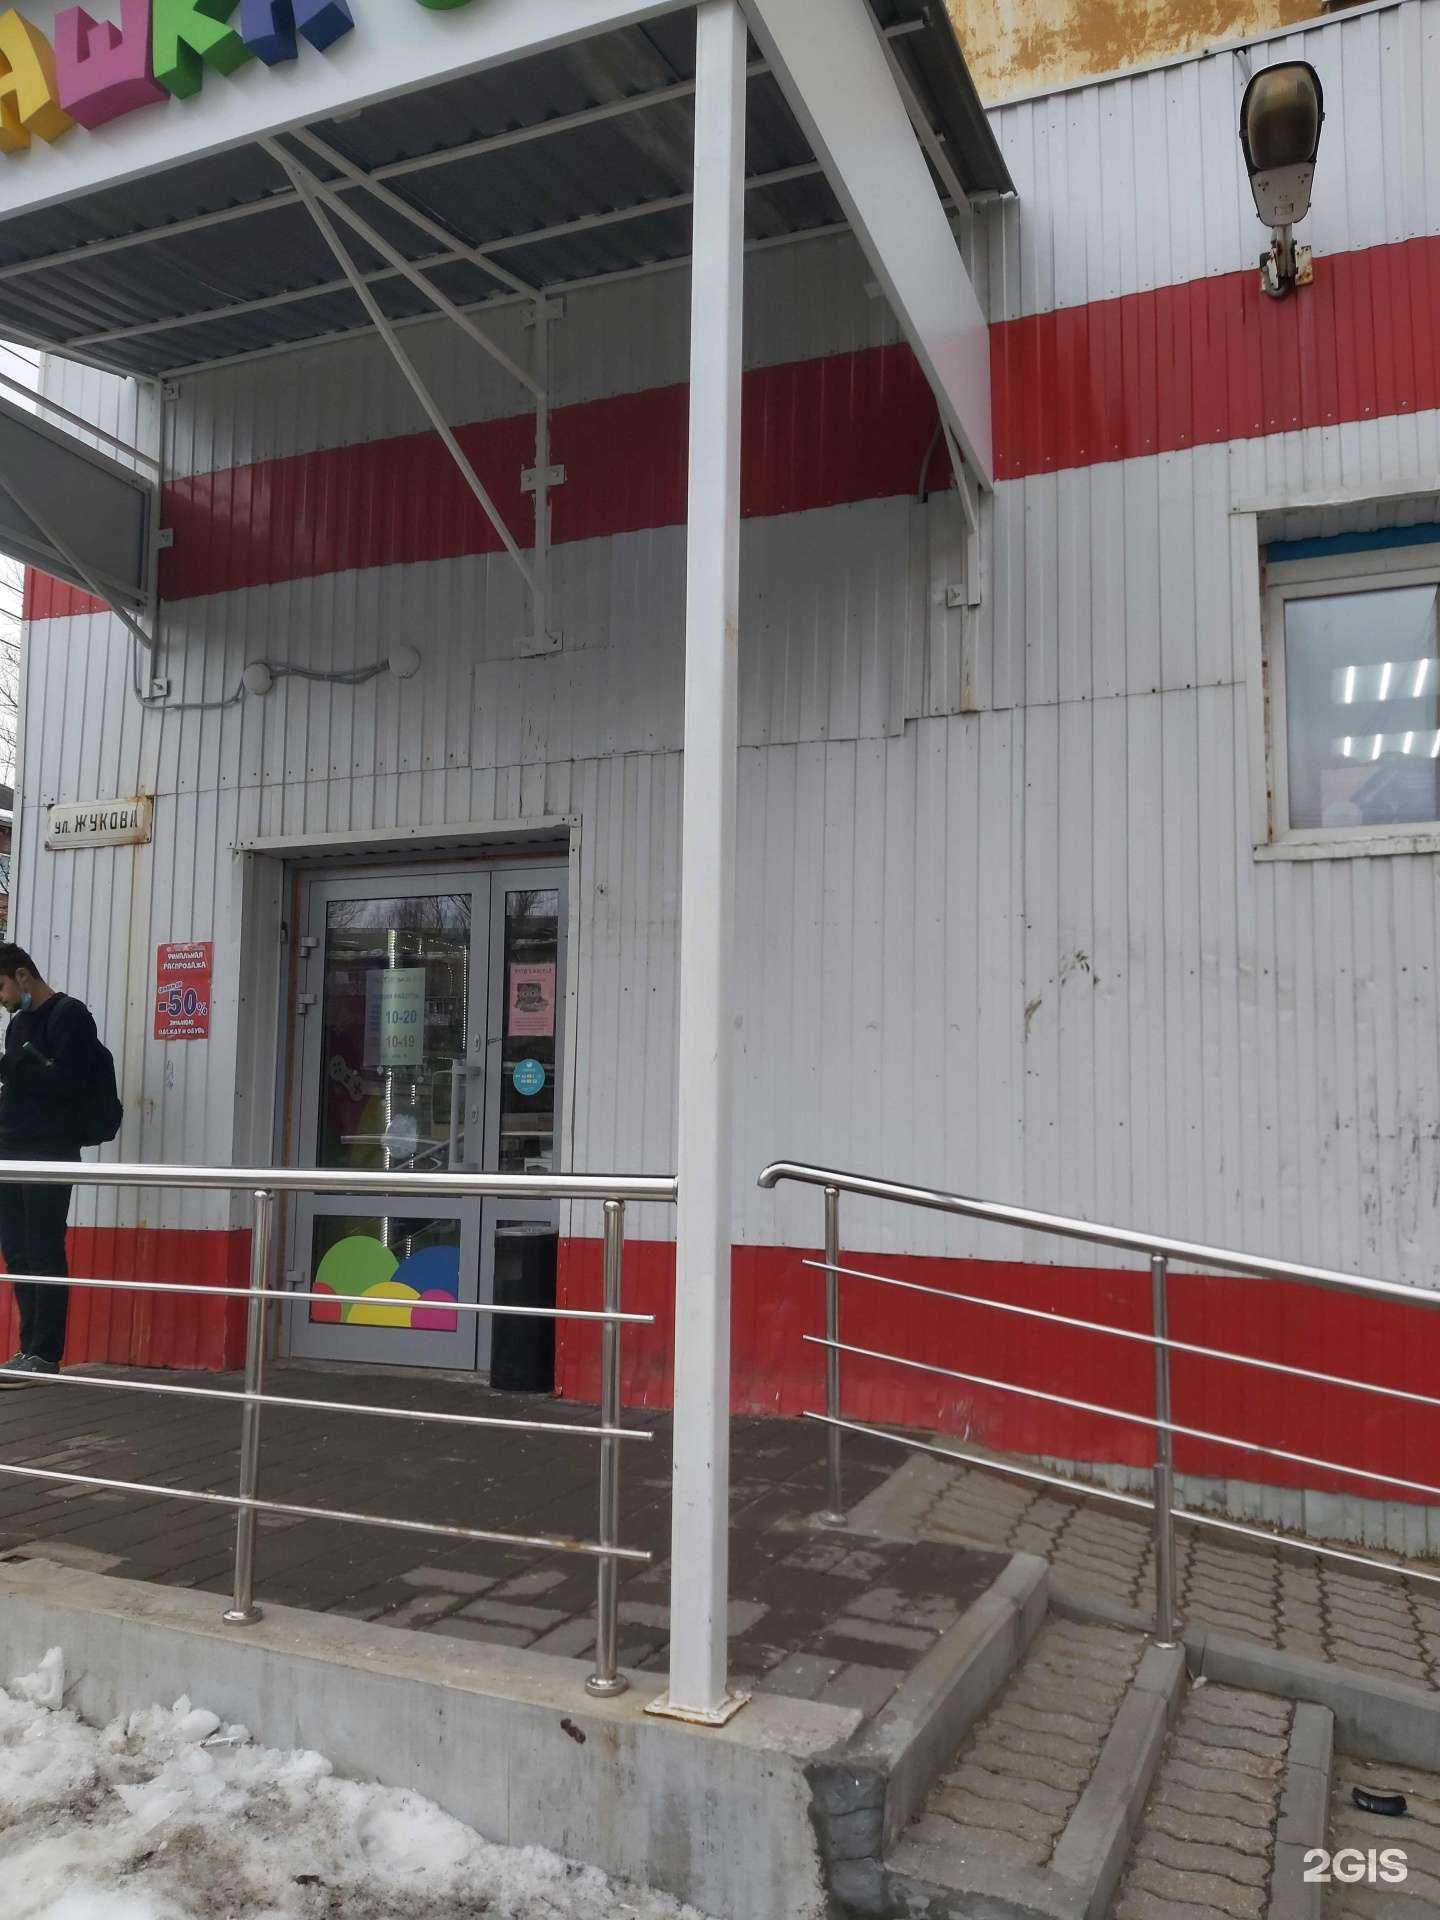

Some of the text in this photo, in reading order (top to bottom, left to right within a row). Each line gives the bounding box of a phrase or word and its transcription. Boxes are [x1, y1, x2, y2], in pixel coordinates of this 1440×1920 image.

[163, 961, 207, 970] РАСПРОДАЖА
[157, 988, 208, 1017] -50%
[386, 1010, 417, 1024] 10-20
[386, 1035, 415, 1049] 10-19
